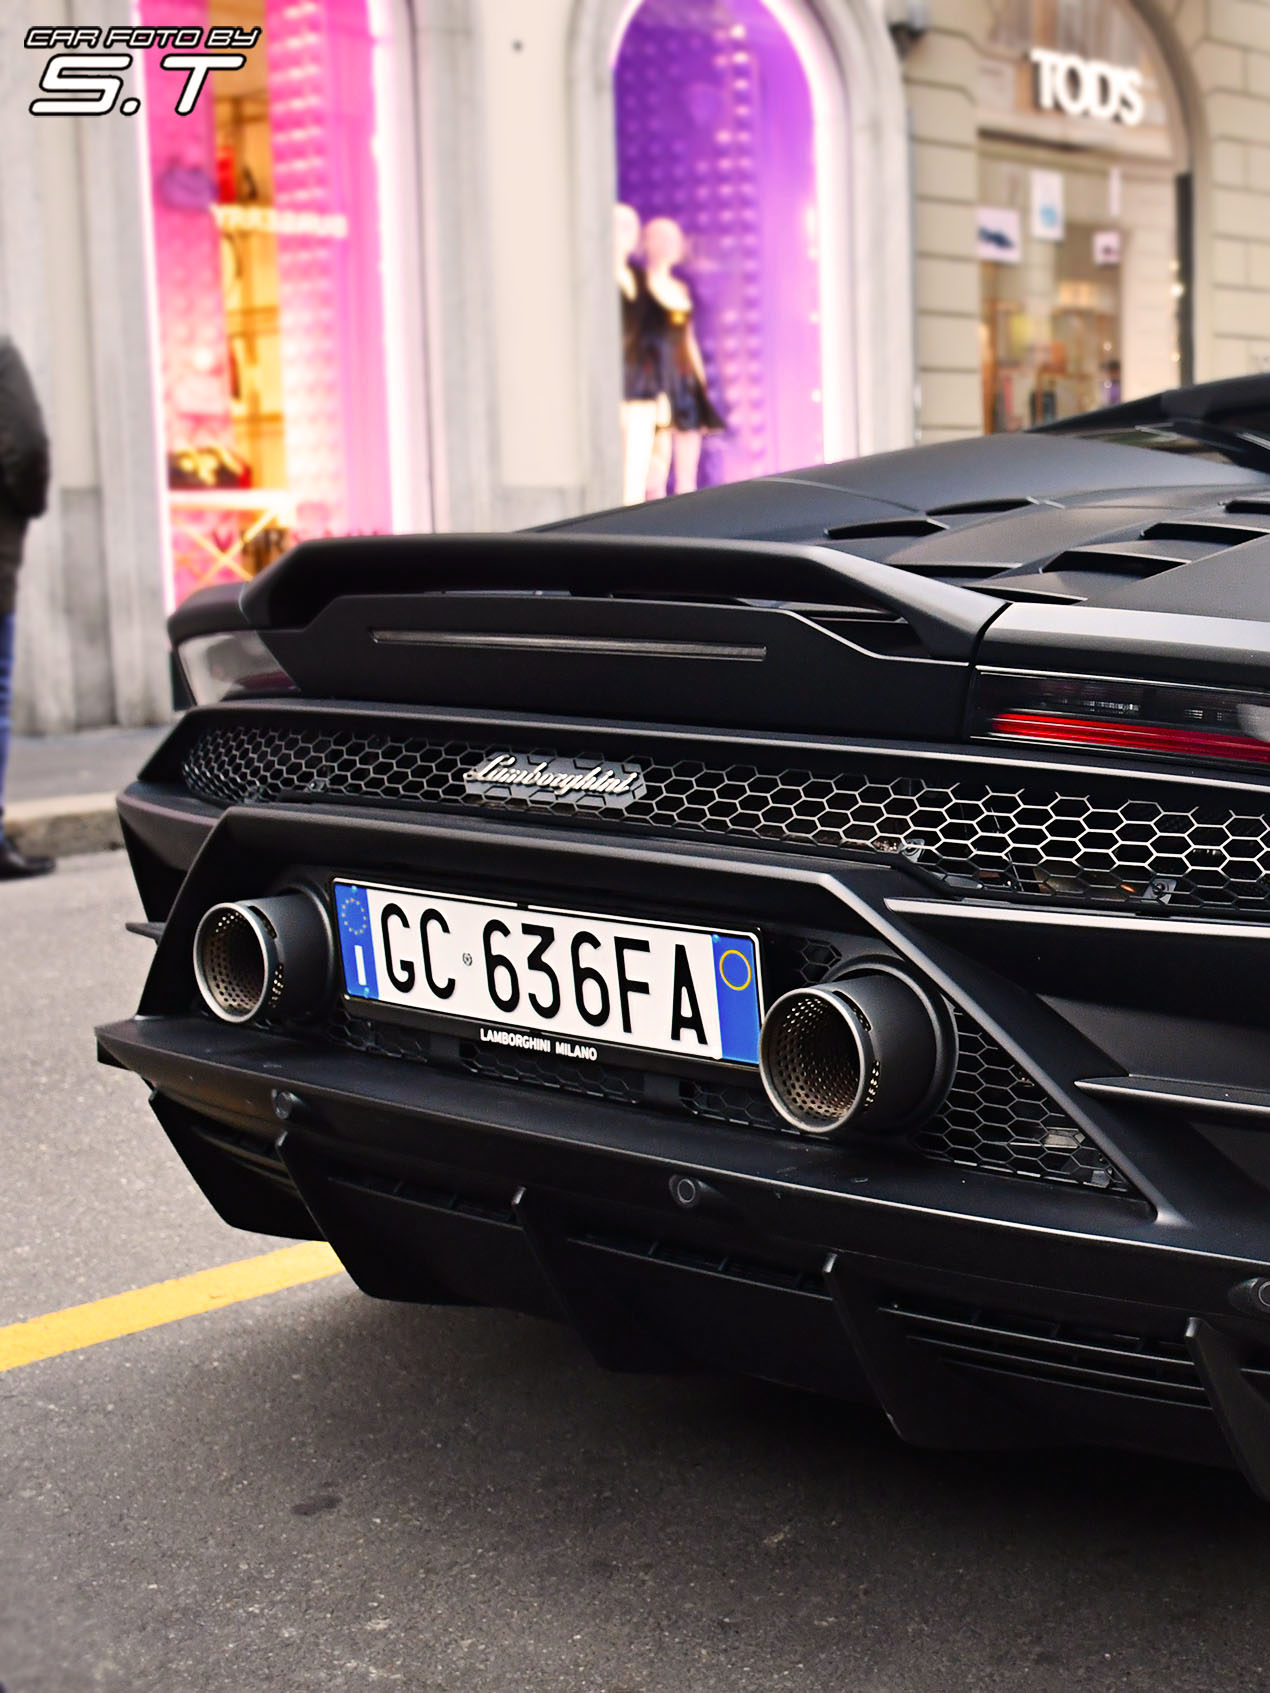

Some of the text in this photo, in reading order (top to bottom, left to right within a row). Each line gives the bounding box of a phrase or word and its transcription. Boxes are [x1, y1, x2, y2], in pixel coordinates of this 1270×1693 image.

[463, 754, 638, 796] Lamborghini
[380, 902, 456, 1000] GC
[482, 918, 709, 1047] 636FA
[480, 1028, 598, 1061] LAMBORGHINI MILANO
